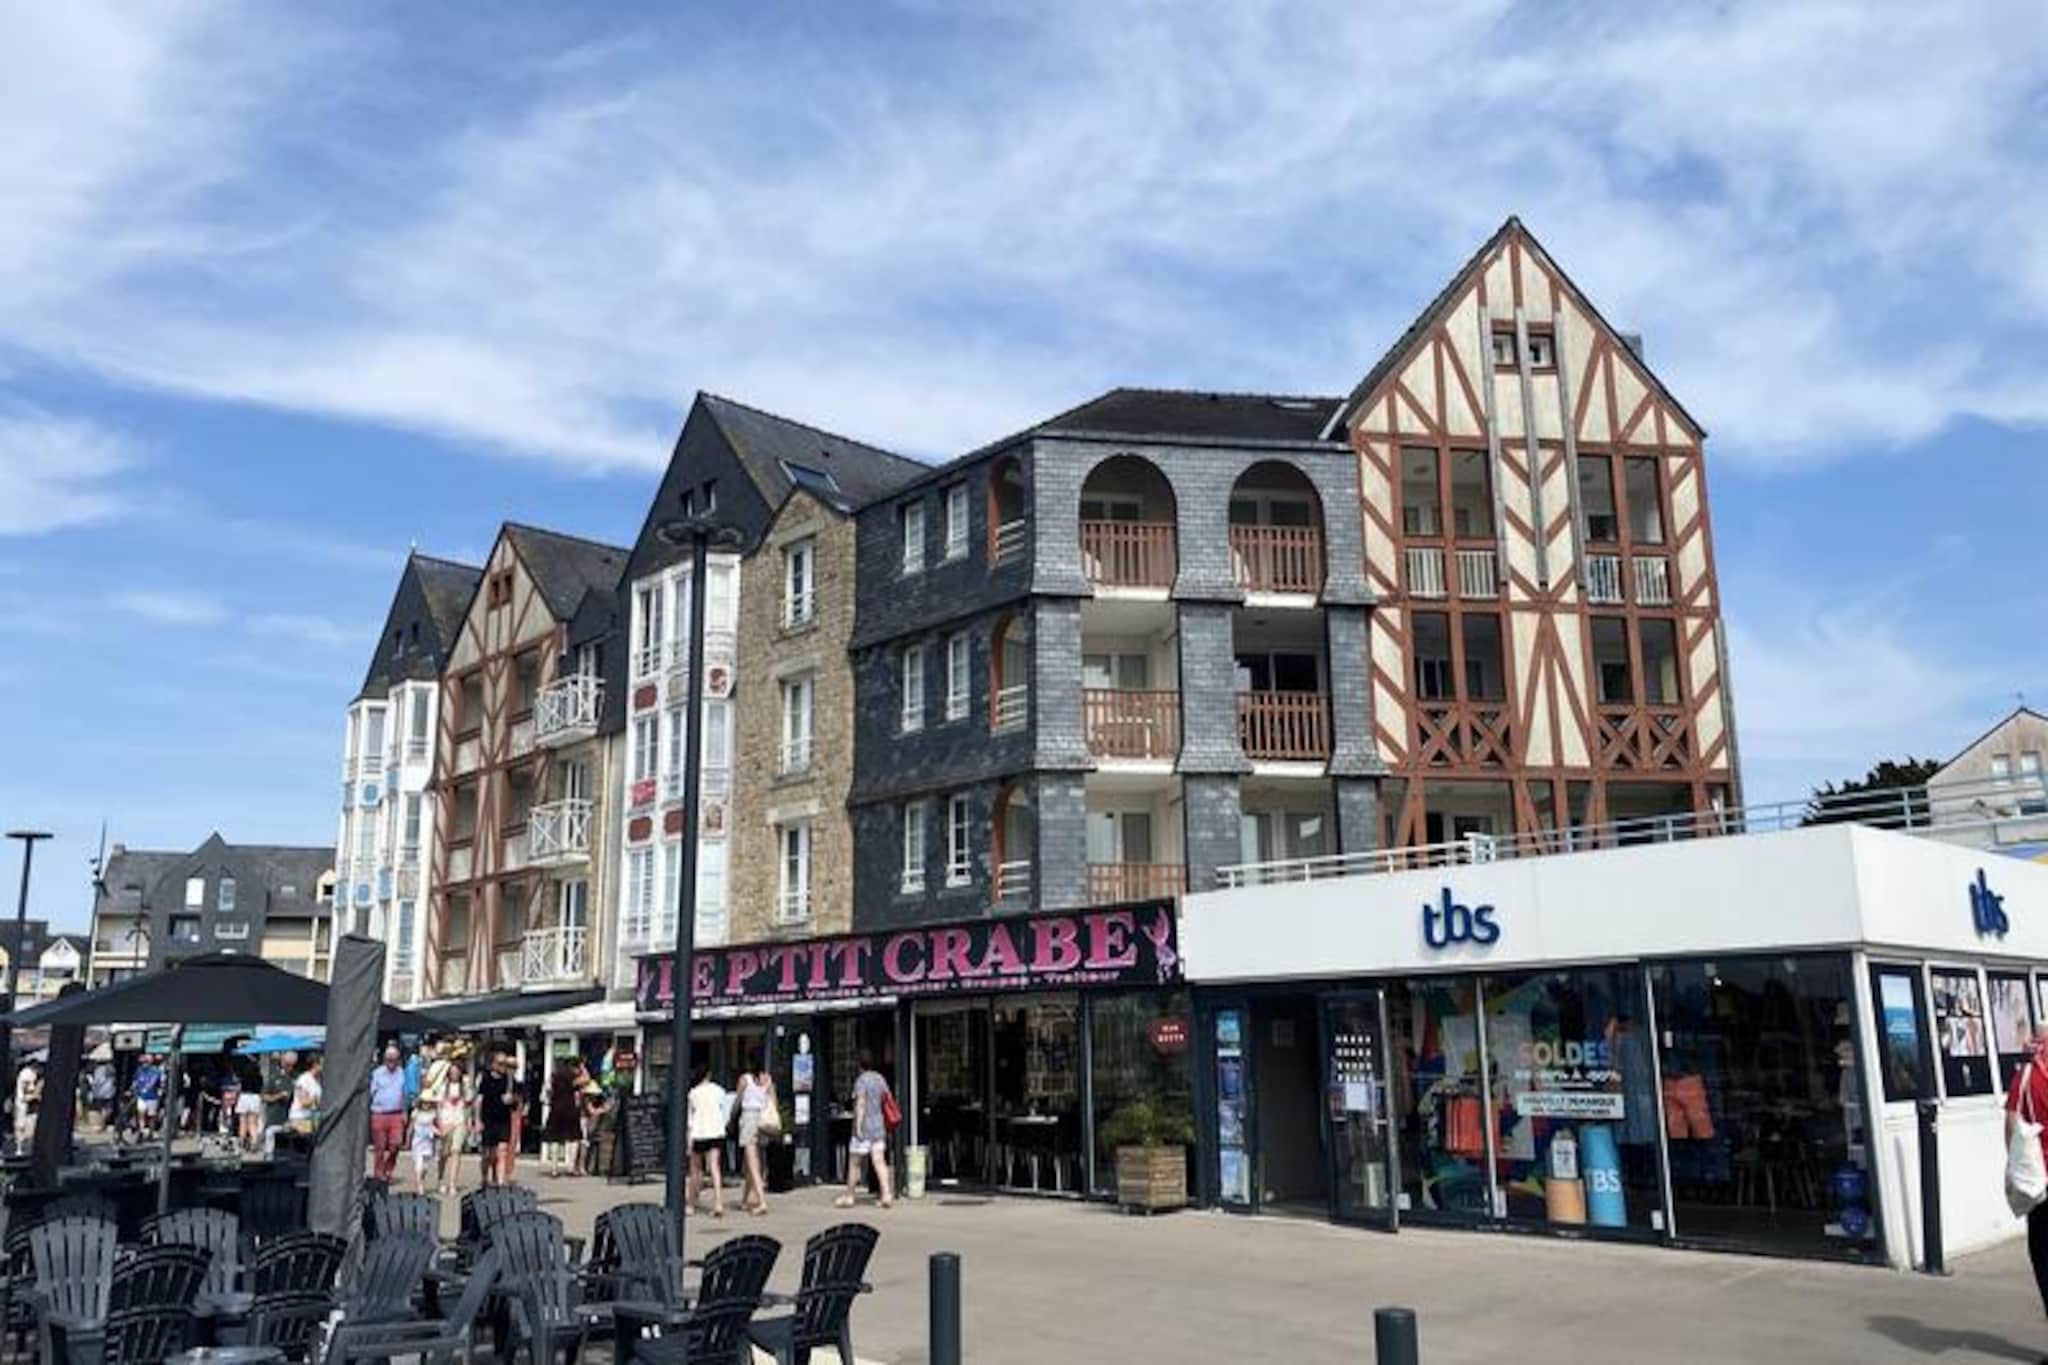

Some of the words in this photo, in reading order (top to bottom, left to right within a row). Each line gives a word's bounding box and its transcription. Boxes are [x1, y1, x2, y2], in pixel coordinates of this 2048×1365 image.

[1422, 887, 1501, 949] tbs
[725, 939, 871, 993] P'TIT
[883, 910, 1137, 983] CRABE
[1044, 972, 1120, 983] Traiteur
[1518, 1041, 1609, 1067] SOLDES
[1583, 1168, 1621, 1193] TBS
